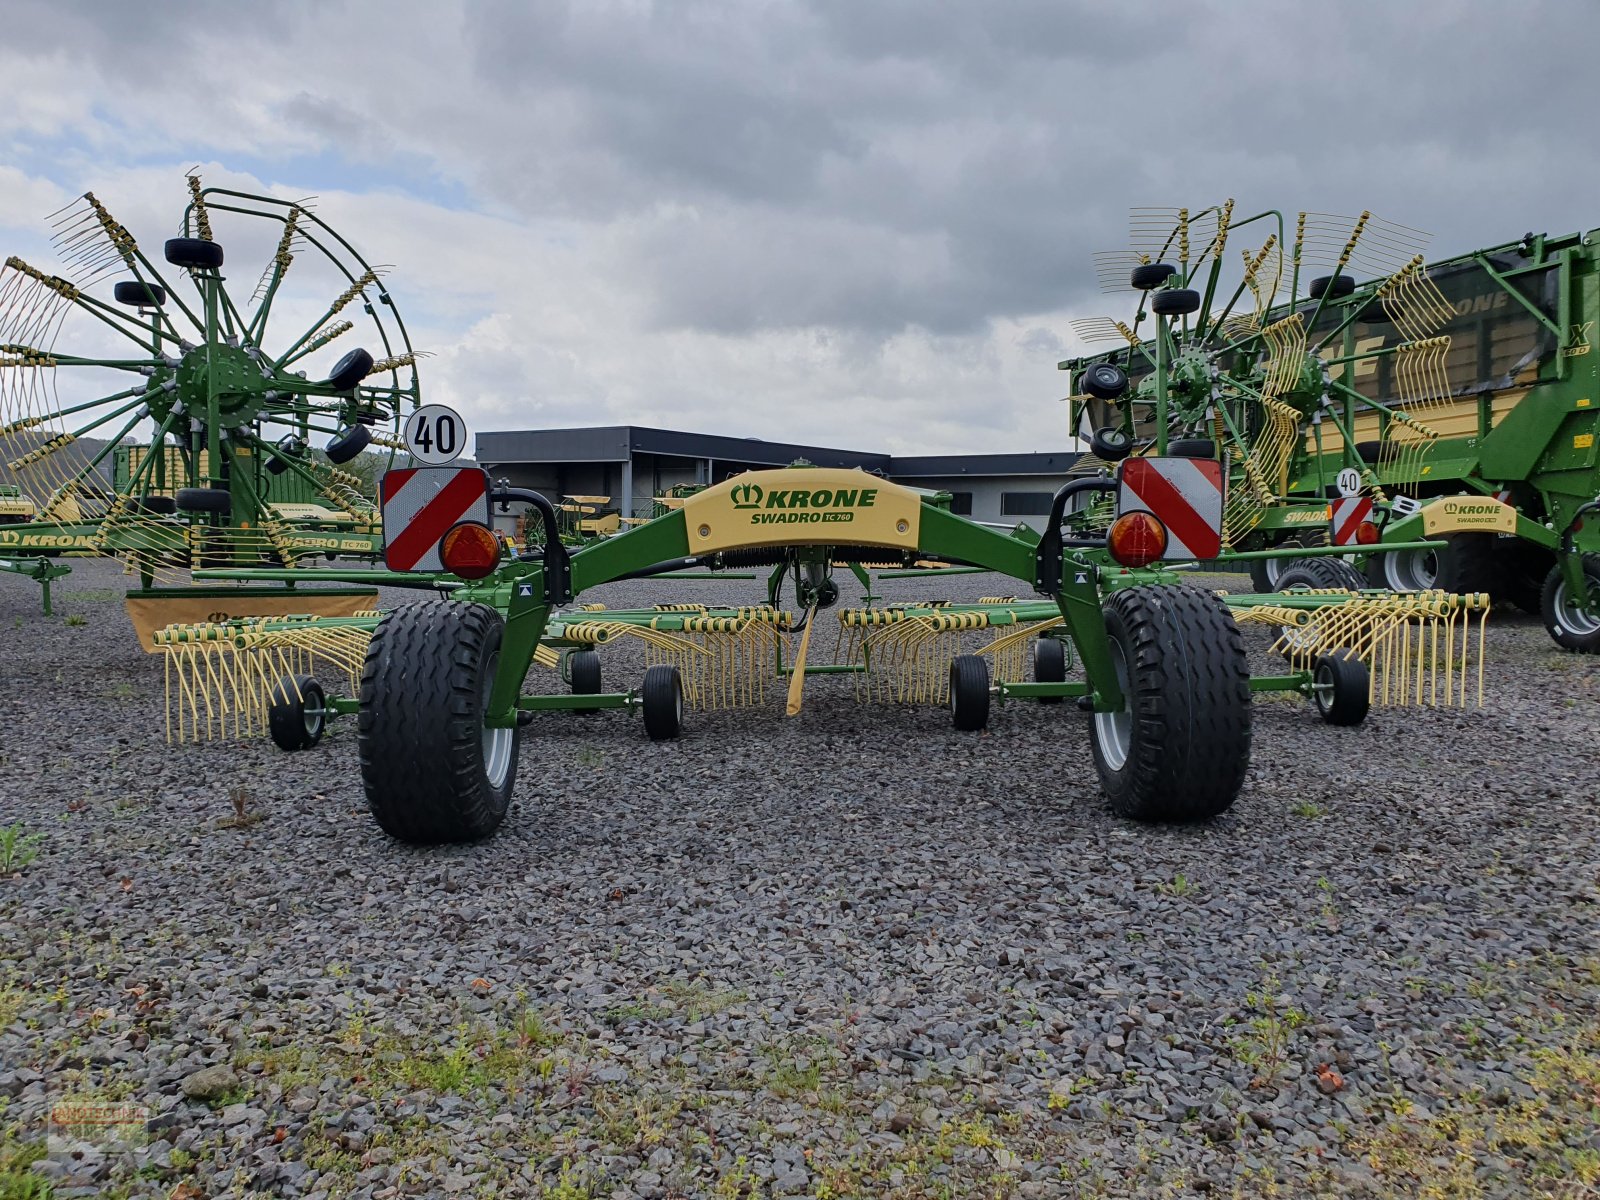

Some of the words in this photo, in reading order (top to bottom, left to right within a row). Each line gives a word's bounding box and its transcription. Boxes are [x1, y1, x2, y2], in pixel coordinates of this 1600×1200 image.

[414, 415, 455, 454] 40
[1341, 473, 1357, 492] 40
[765, 489, 878, 509] KRONE
[1284, 511, 1329, 522] SWADR
[1458, 505, 1501, 515] KRONE
[751, 512, 821, 525] SWADRO
[836, 513, 850, 521] 760
[21, 534, 106, 547] KRON
